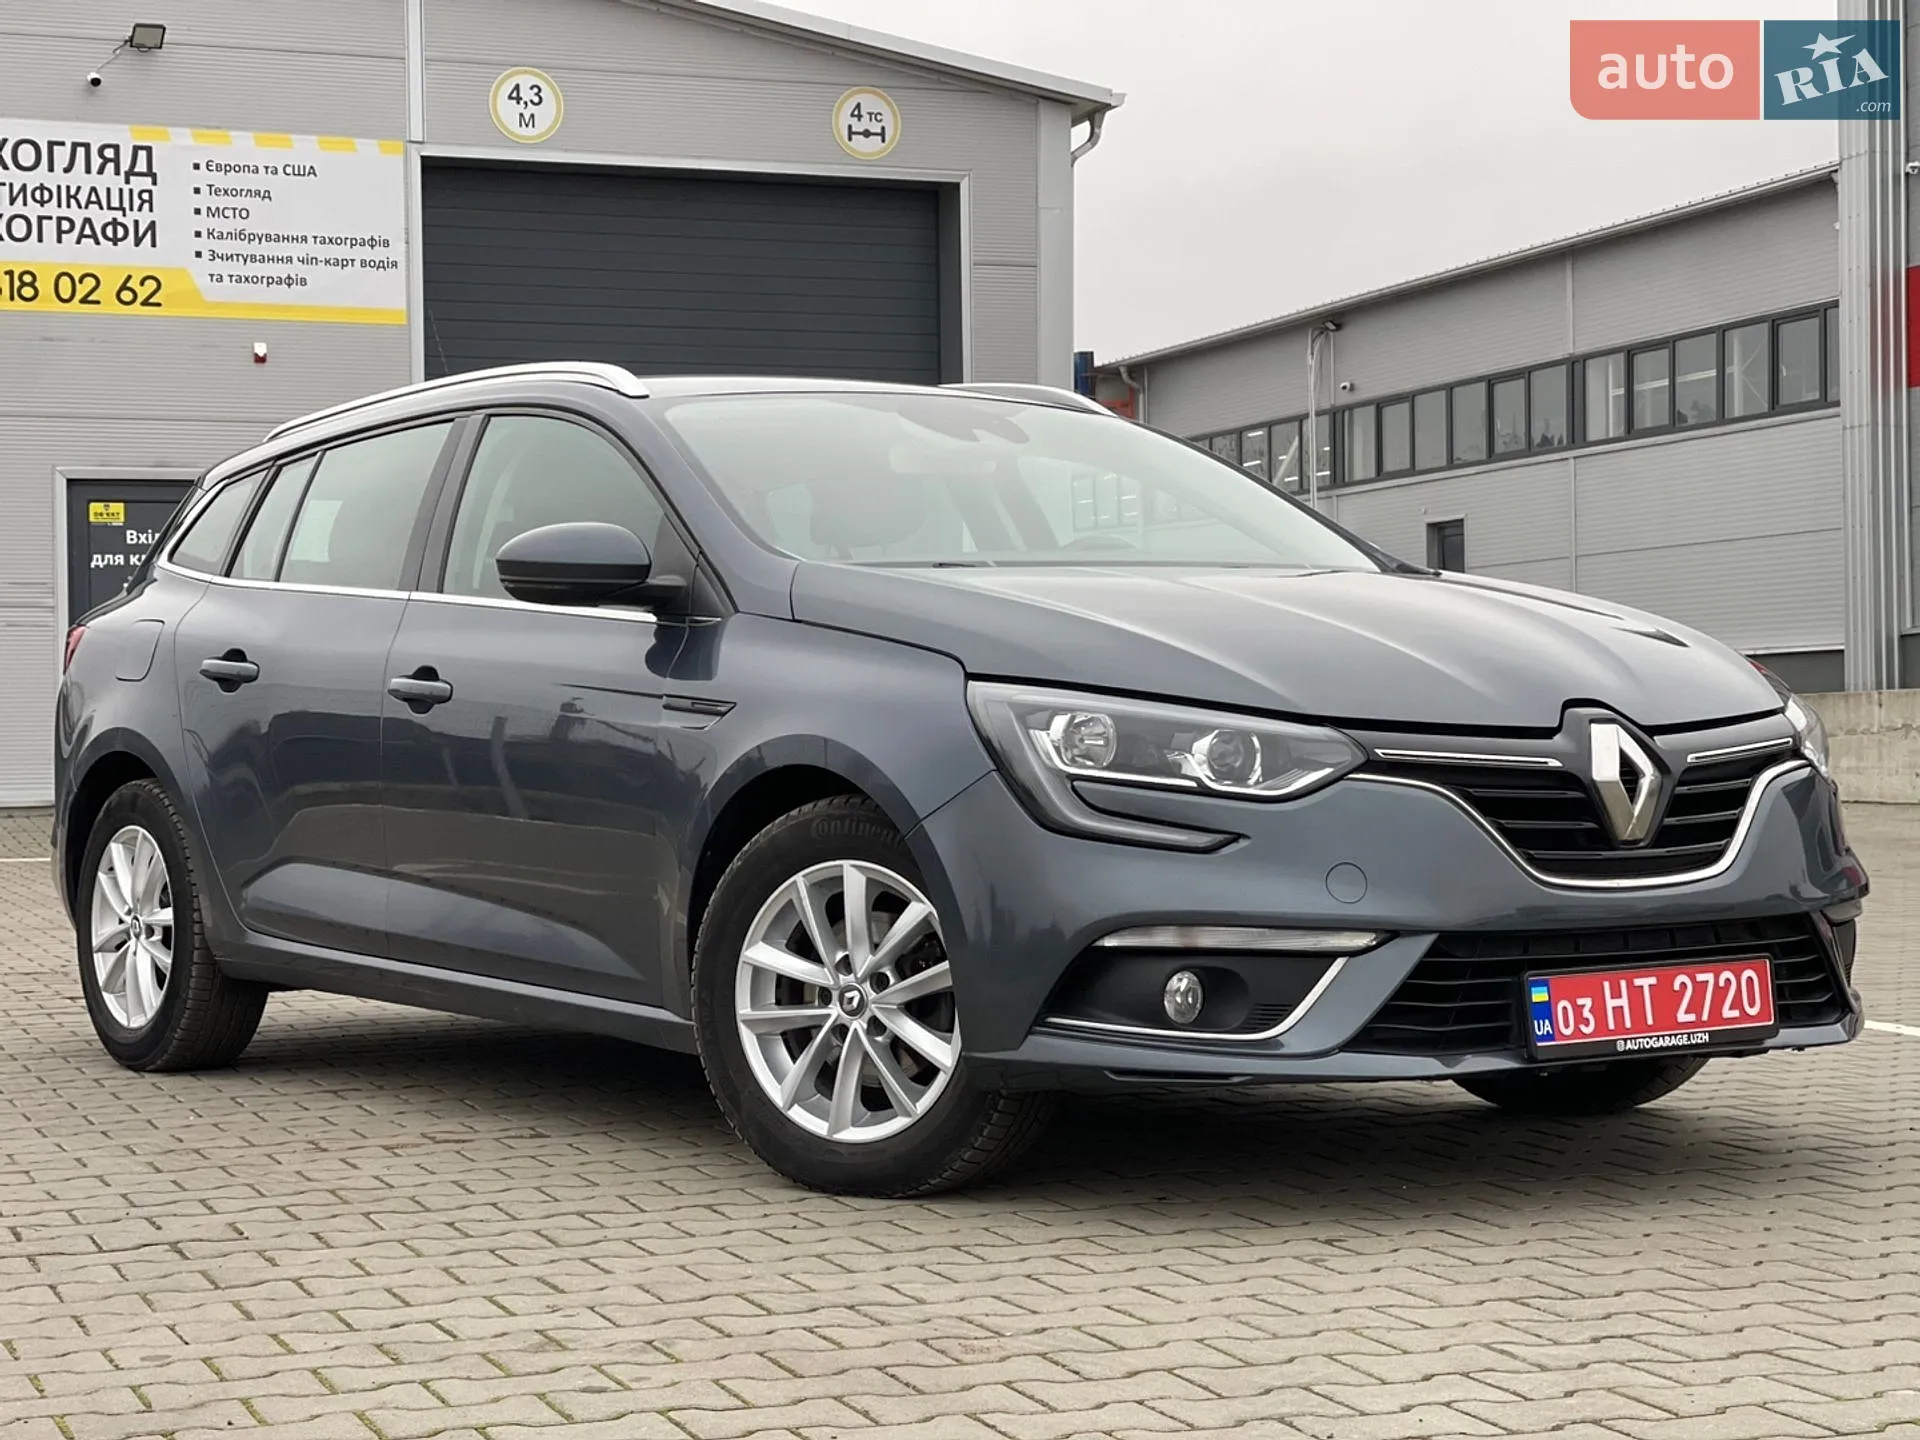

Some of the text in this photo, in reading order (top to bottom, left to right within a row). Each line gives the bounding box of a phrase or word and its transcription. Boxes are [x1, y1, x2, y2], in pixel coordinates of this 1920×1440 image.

[507, 83, 543, 109] 4,3
[850, 102, 863, 122] 4
[205, 160, 318, 178] Європа та США
[206, 184, 272, 201] Техогляд
[206, 206, 250, 220] МСТО
[0, 213, 157, 248] ОГРАФИ
[206, 228, 390, 249] Калібрування тахографів
[208, 250, 398, 271] Зчитування чіп-карт водія
[0, 269, 162, 307] 18 02 62
[208, 272, 308, 289] та тахографів
[90, 554, 124, 568] для
[1557, 997, 1596, 1036] 03
[1673, 969, 1761, 1023] 2720
[1534, 1019, 1552, 1036] UA
